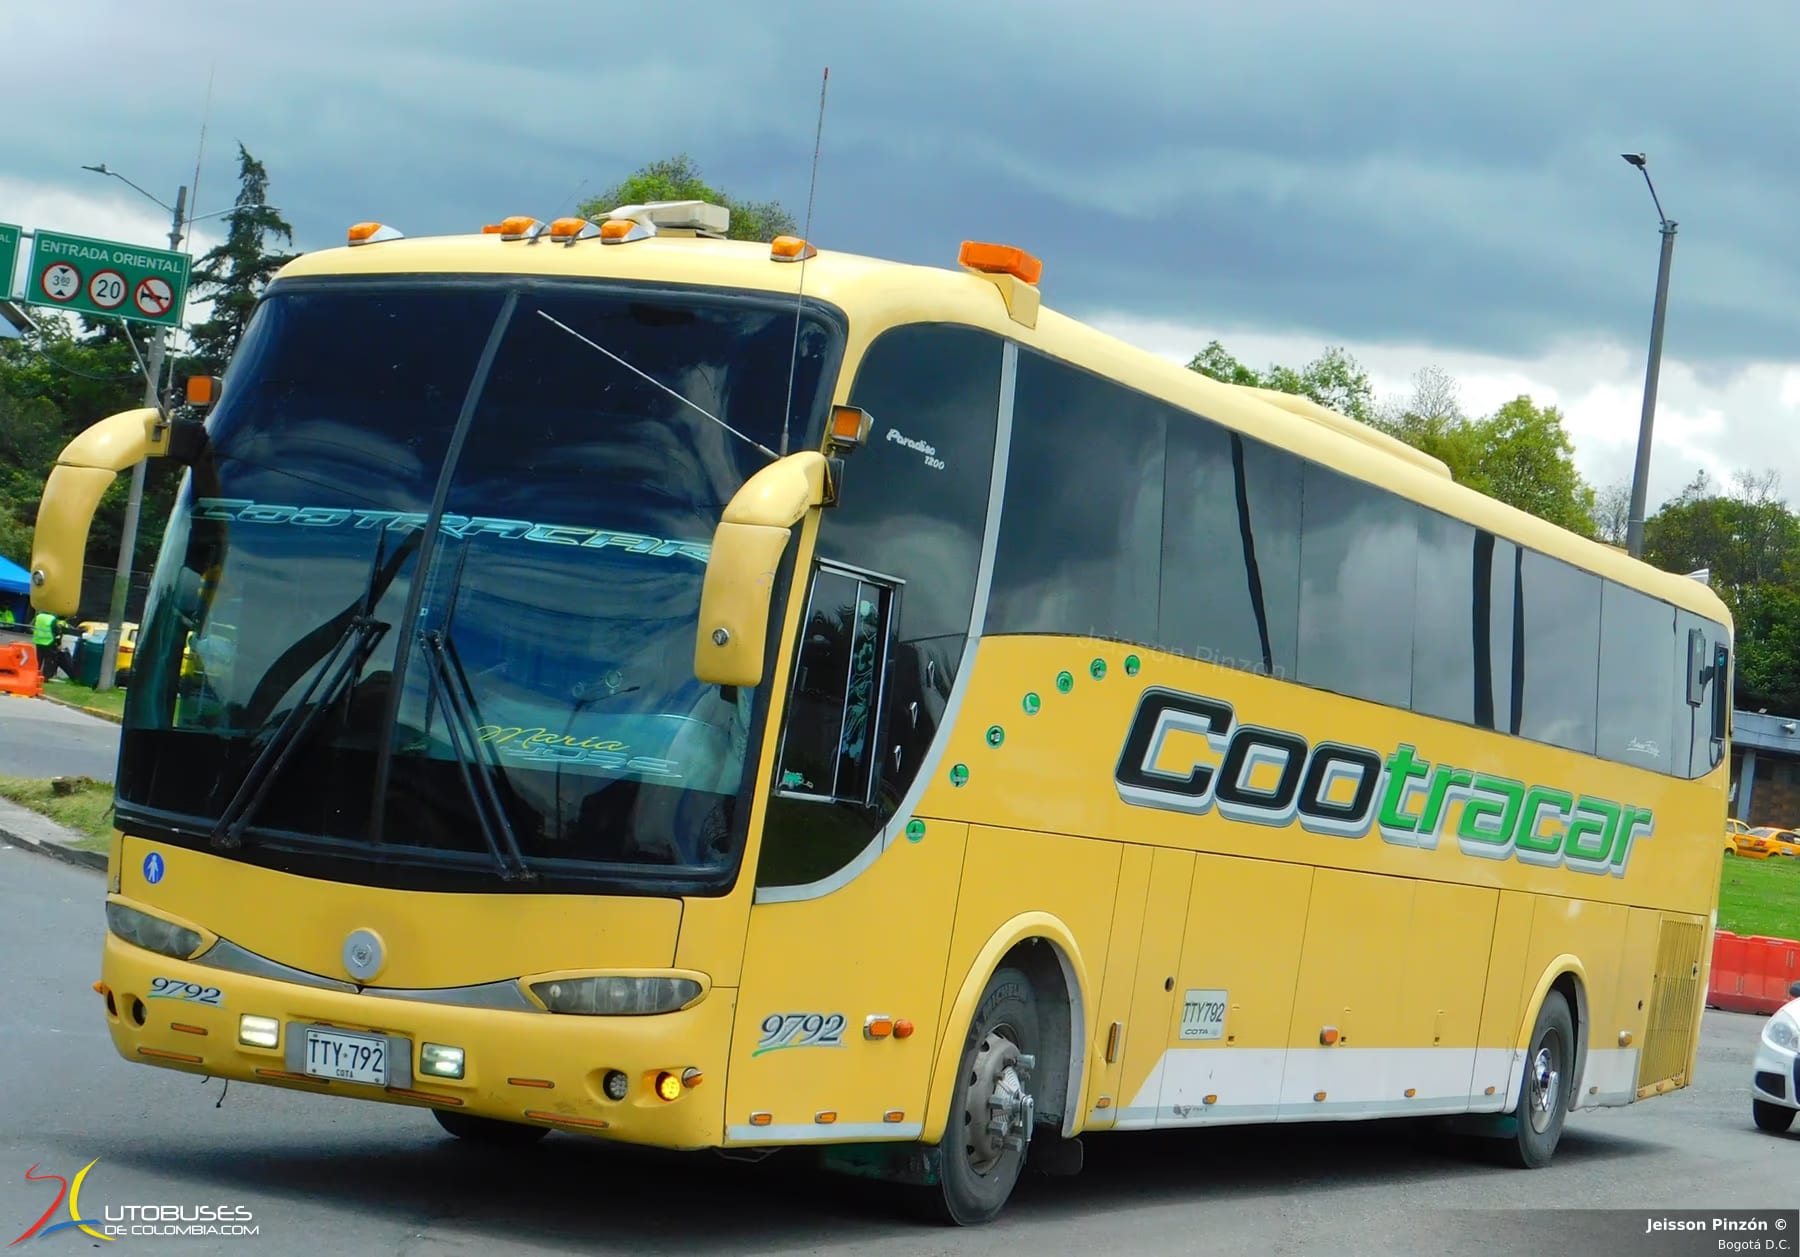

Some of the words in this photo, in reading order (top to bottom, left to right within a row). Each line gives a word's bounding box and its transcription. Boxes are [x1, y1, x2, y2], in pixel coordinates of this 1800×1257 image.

[40, 239, 109, 261] ENTRADA
[112, 251, 181, 273] ORIENTAL
[96, 280, 121, 299] 20
[886, 428, 936, 456] Paradiso
[924, 455, 945, 470] 1200
[475, 724, 630, 751] Maria
[1113, 685, 1655, 878] Cootracar
[151, 977, 221, 1004] 9792
[1183, 1002, 1225, 1023] TTY792
[758, 1013, 846, 1046] 9792
[336, 1068, 354, 1079] COTA
